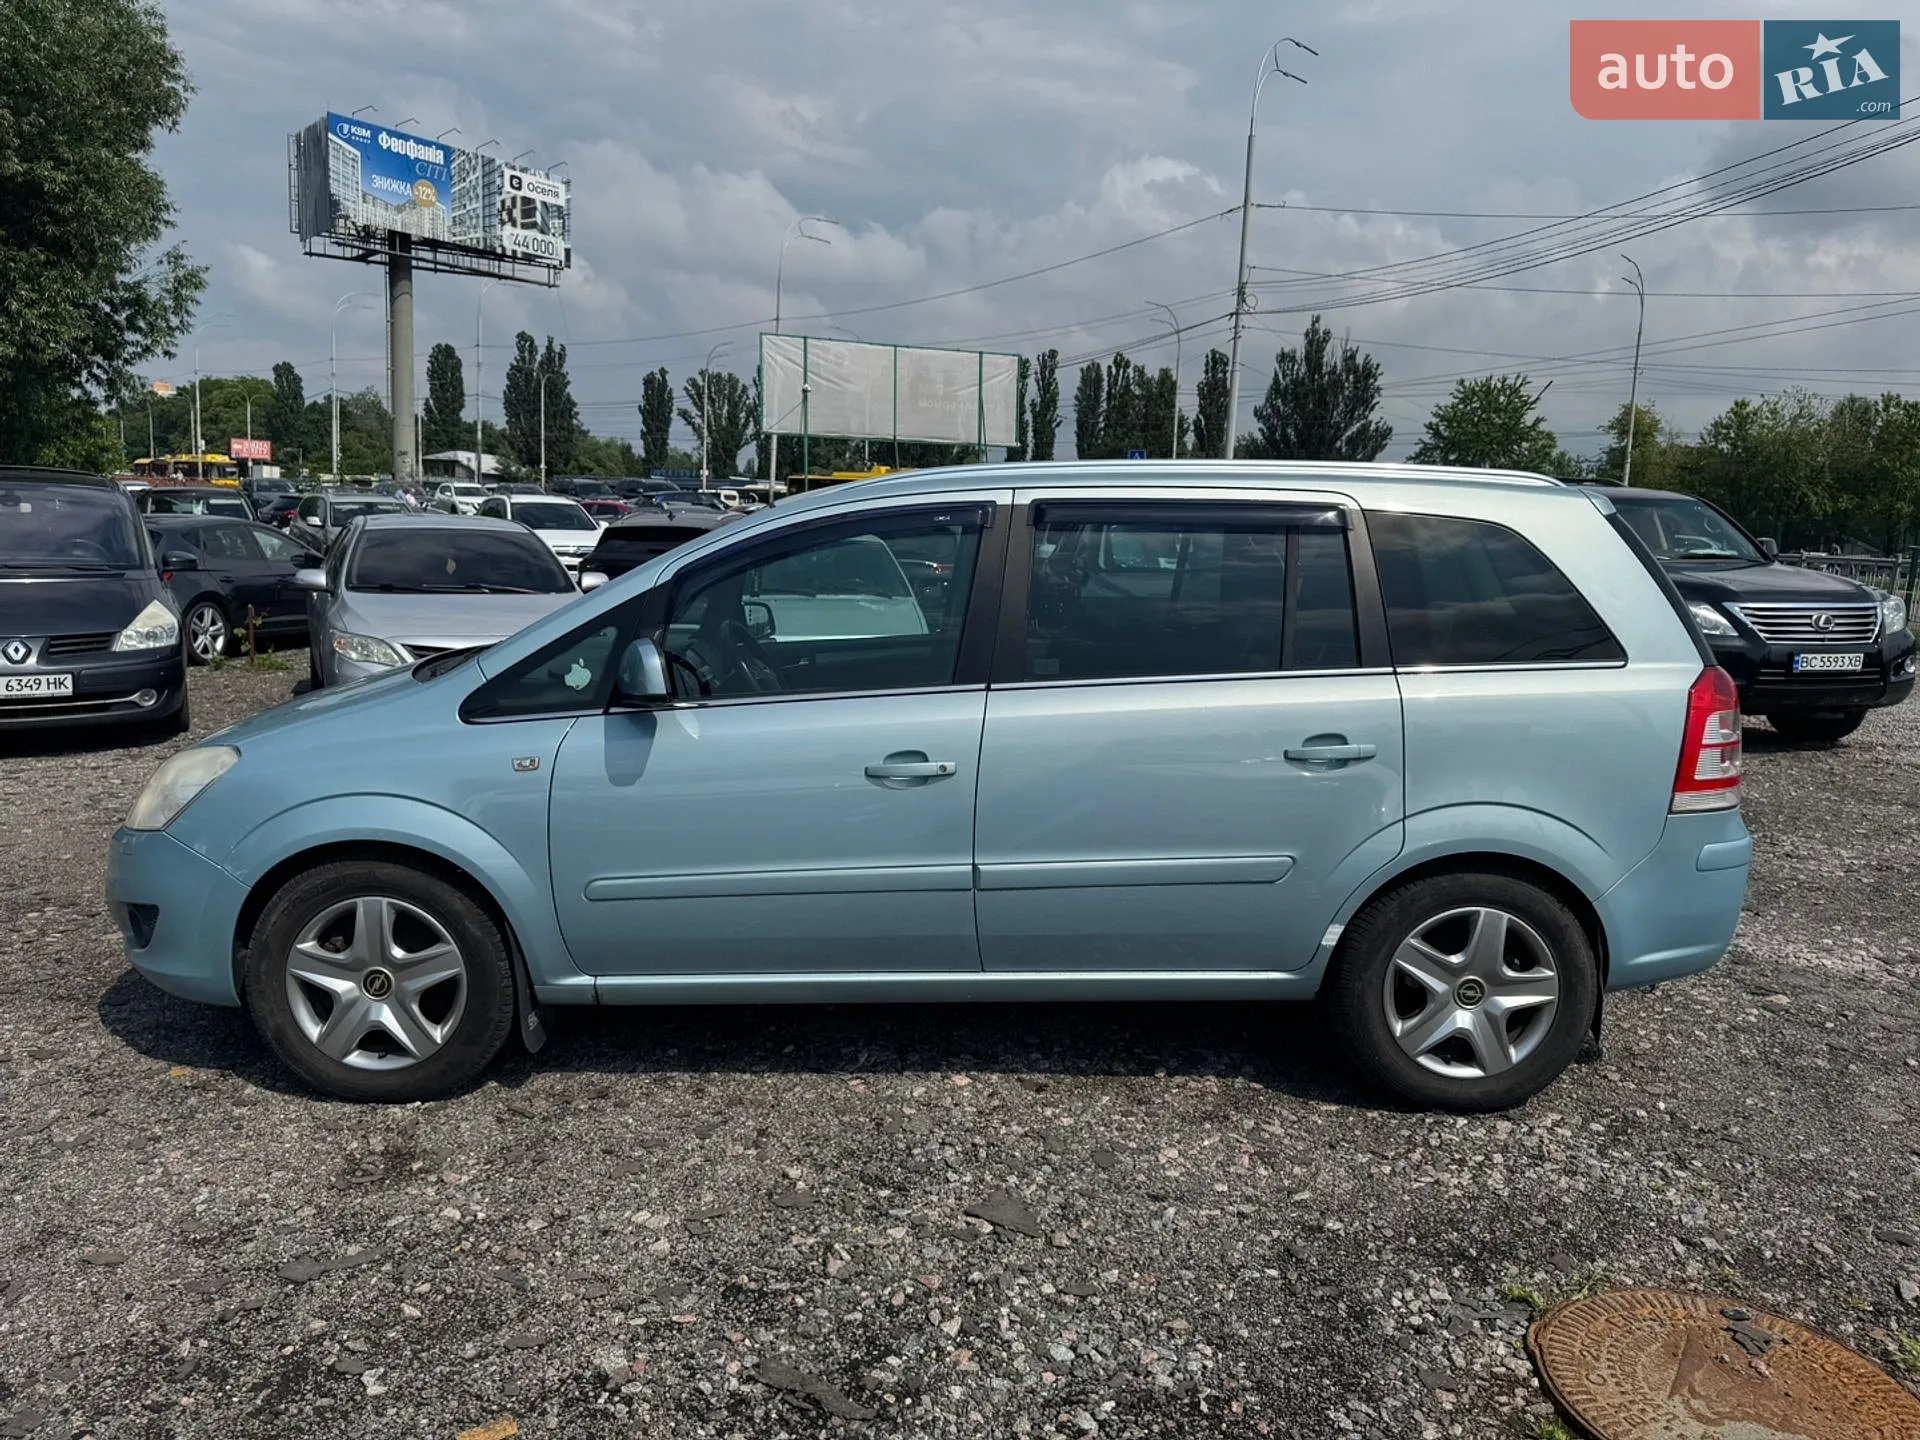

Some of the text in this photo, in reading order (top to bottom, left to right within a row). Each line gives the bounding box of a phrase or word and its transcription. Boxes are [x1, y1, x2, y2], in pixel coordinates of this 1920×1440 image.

[378, 131, 444, 164] Феофанія
[371, 174, 412, 197] ЗНИЖКА
[526, 182, 559, 199] Оселя
[1800, 655, 1817, 668] BC
[1819, 655, 1846, 668] 5593
[5, 676, 69, 692] 6349 HK
